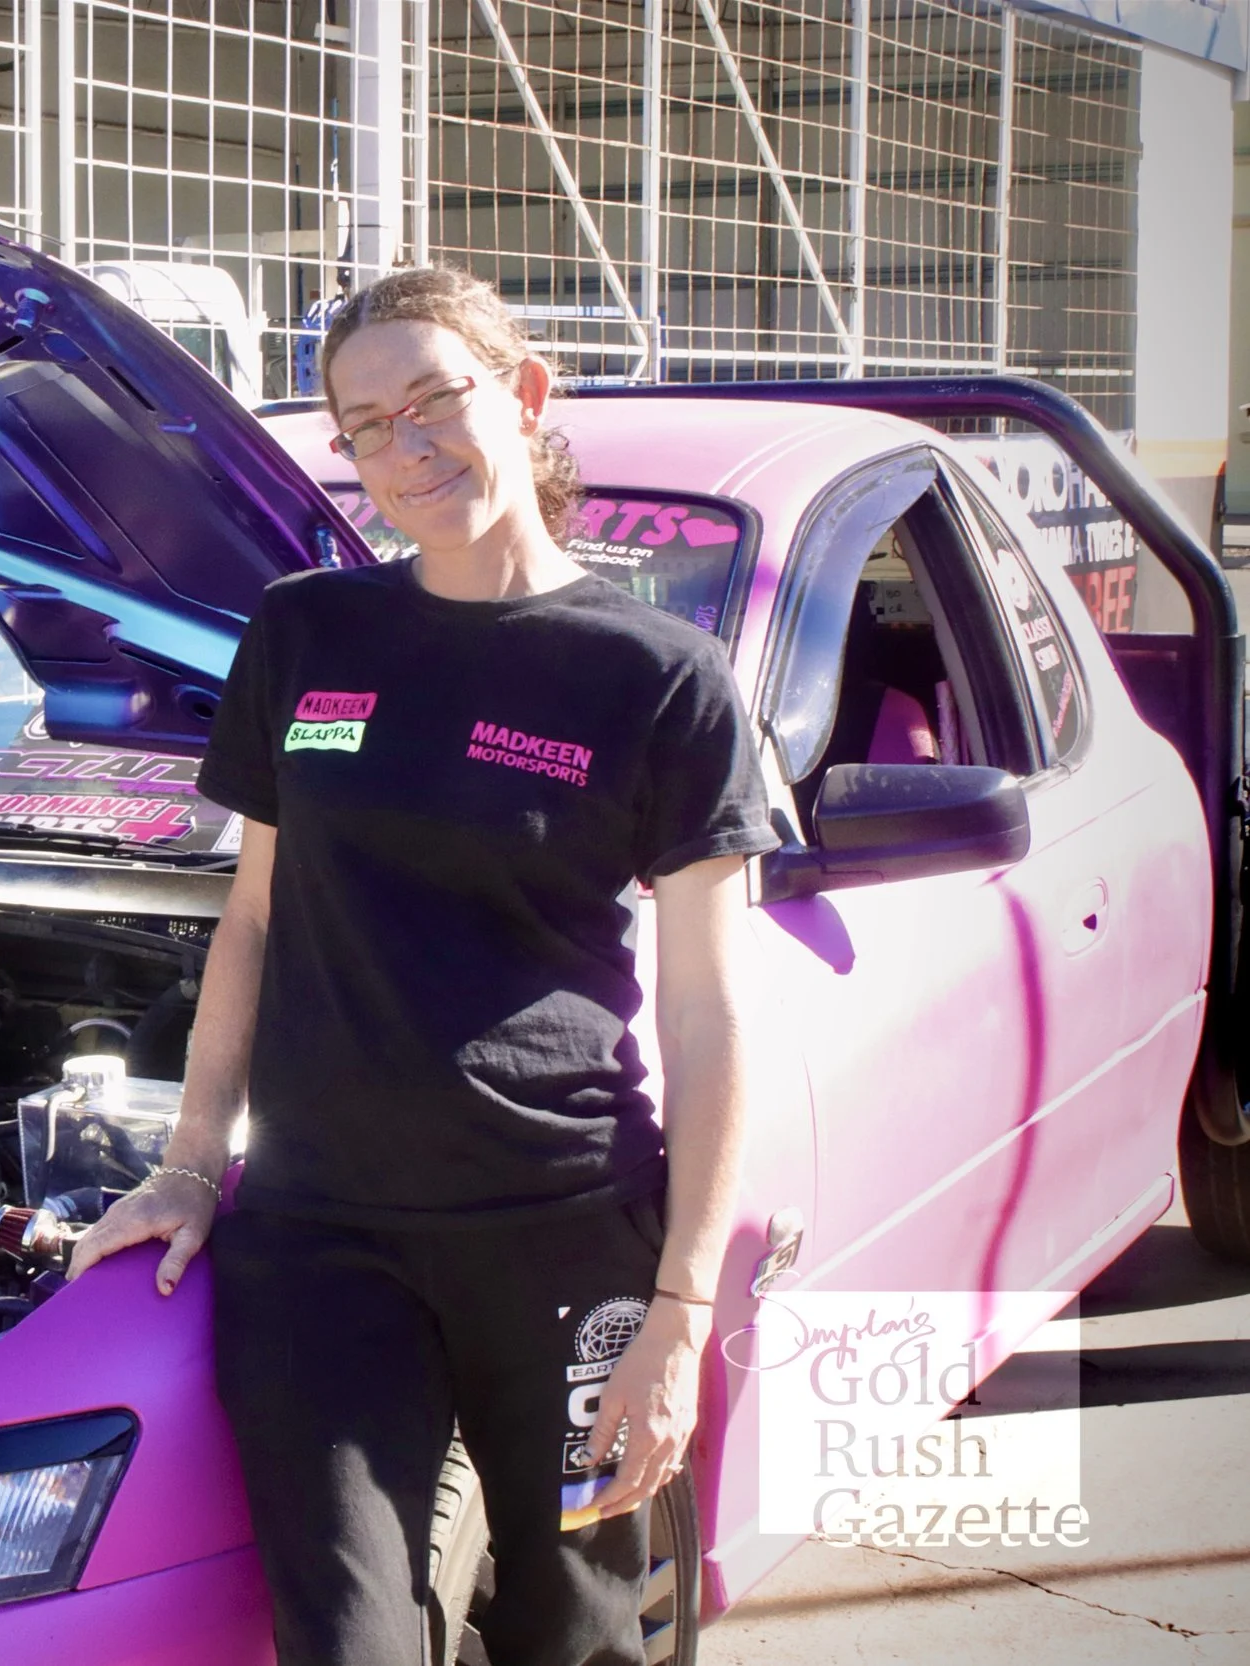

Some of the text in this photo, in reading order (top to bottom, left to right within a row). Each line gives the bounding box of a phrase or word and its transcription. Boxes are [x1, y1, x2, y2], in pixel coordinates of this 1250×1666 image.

[567, 539, 654, 559] Find us on
[302, 697, 370, 716] MADKEEN
[290, 726, 356, 741] SLAPPA
[470, 720, 593, 771] MADKEEN
[466, 743, 588, 787] MOTORSPORTS
